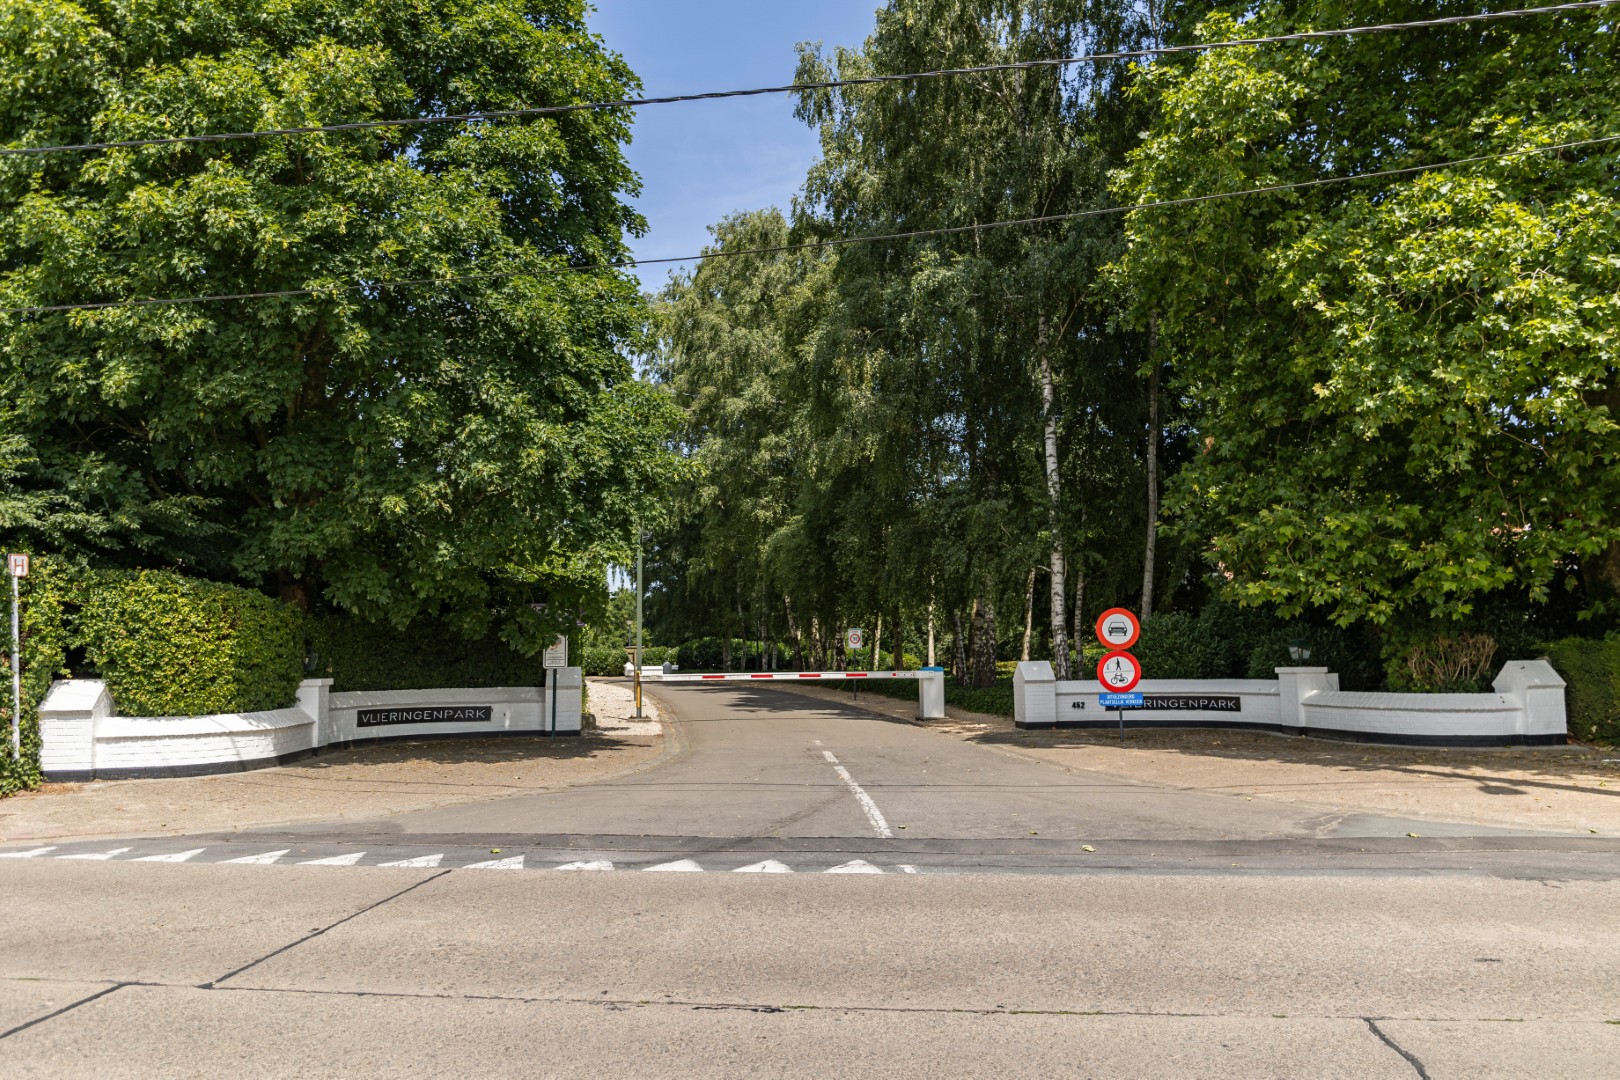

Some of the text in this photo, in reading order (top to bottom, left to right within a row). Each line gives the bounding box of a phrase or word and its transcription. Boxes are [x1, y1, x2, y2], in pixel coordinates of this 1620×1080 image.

[14, 558, 25, 572] H
[1113, 698, 1237, 710] RINGENPARK
[361, 709, 487, 723] VLIERINGENPARK
